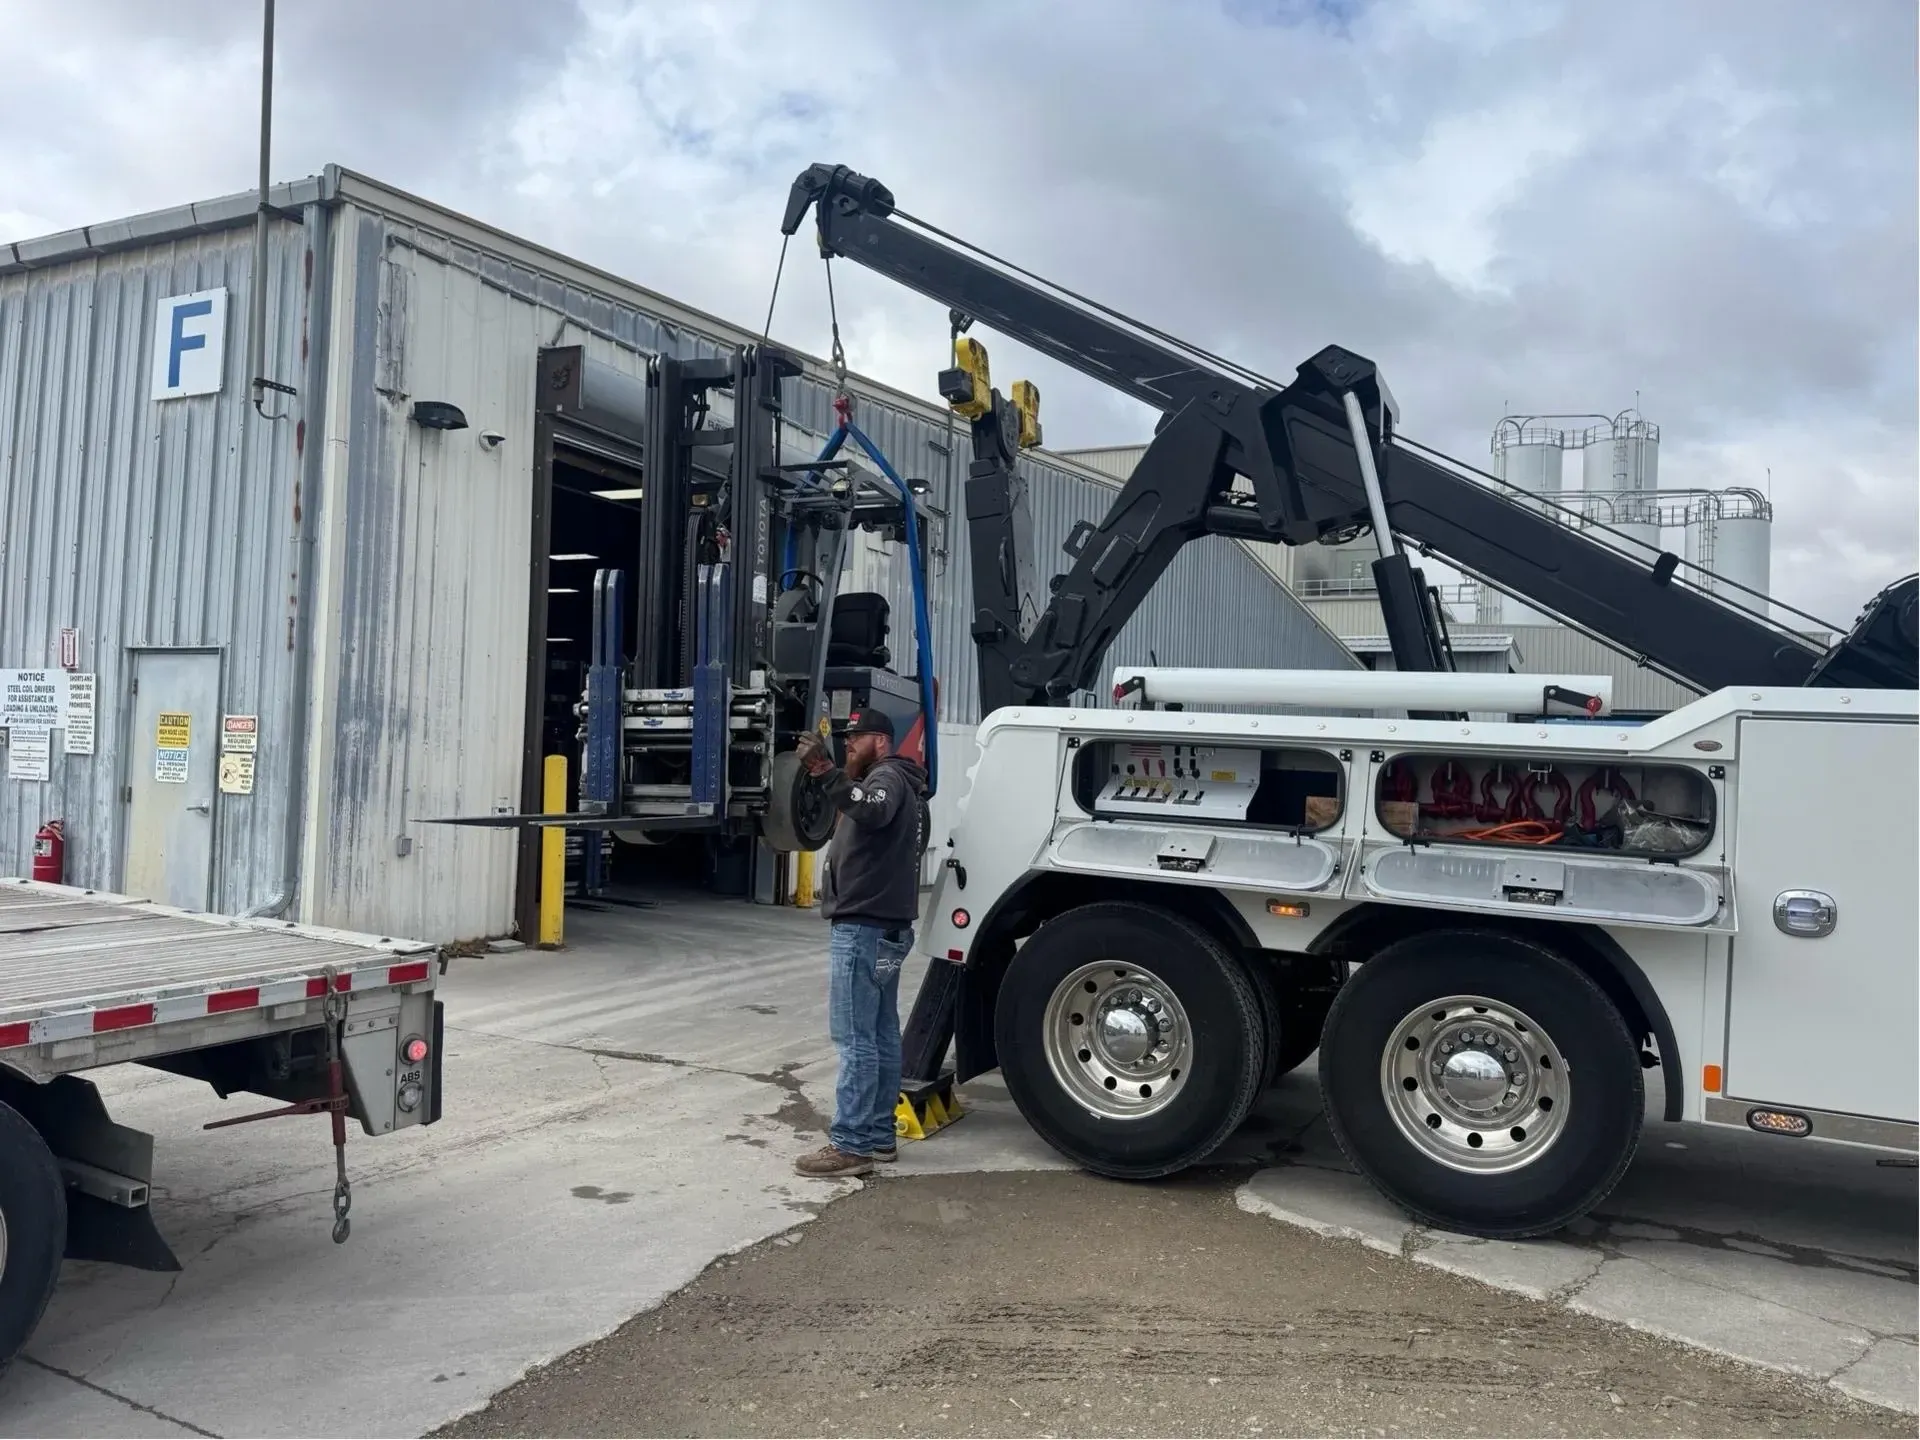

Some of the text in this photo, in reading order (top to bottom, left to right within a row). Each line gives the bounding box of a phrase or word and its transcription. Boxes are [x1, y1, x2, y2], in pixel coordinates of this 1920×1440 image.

[168, 300, 212, 388] F
[757, 499, 767, 564] TOYOTA
[17, 672, 45, 682] NOTICE
[7, 685, 56, 694] STEEL COIL DRIVERS
[8, 694, 54, 703] FOR ASSISTANCE IN
[3, 704, 24, 712] LOADING
[29, 704, 58, 713] UNLOADING
[160, 715, 189, 726] CAUTION
[228, 719, 254, 729] DANGER
[158, 750, 187, 760] NOTICE
[401, 1070, 420, 1083] ABS
